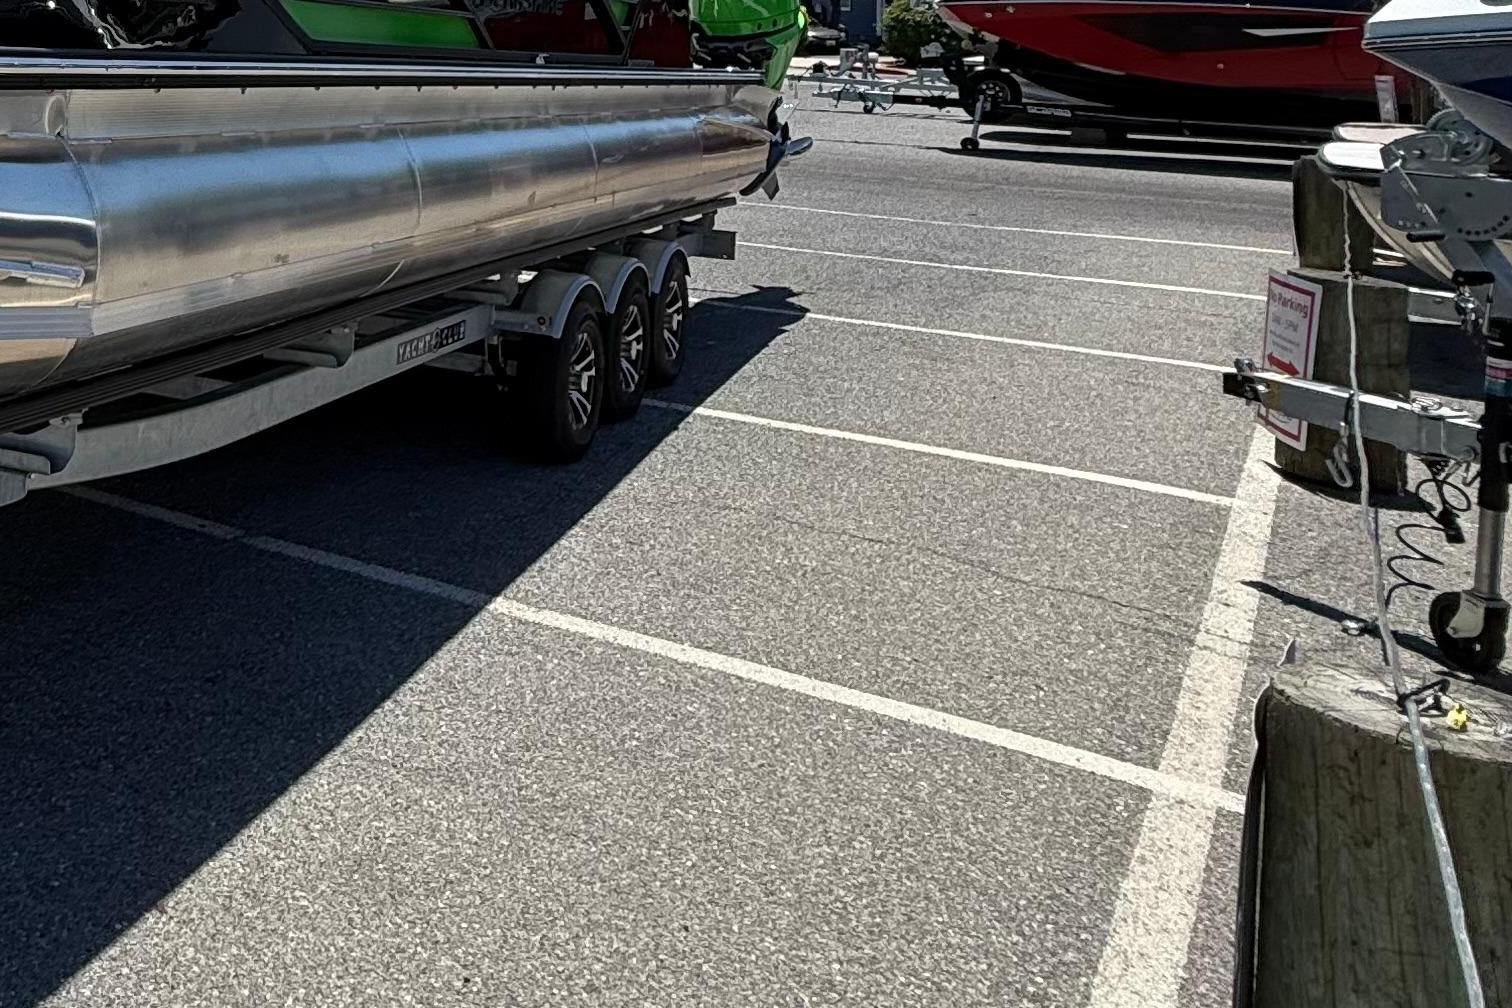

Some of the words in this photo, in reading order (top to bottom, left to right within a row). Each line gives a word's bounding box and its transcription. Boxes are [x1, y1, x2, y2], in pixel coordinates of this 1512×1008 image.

[1277, 291, 1309, 319] Parking
[398, 334, 432, 364] YACHT
[441, 321, 466, 346] CLUB
